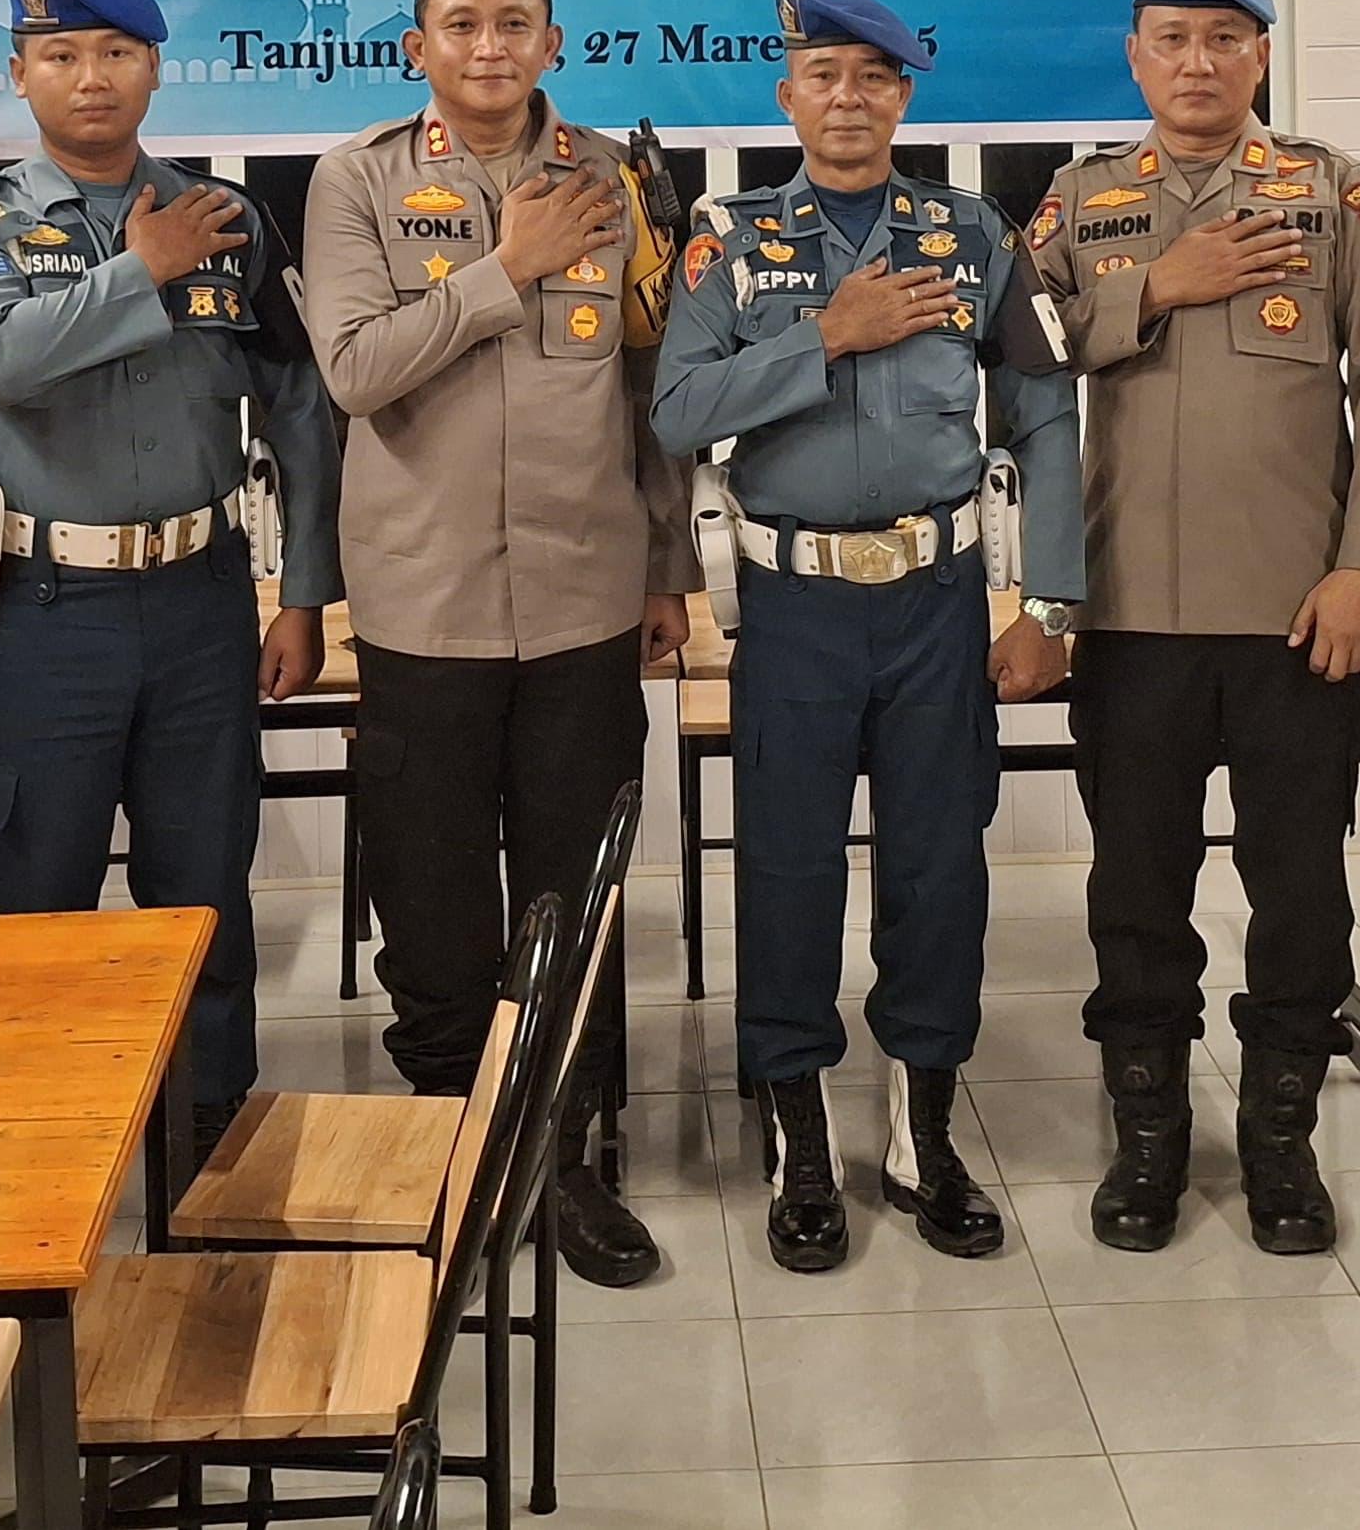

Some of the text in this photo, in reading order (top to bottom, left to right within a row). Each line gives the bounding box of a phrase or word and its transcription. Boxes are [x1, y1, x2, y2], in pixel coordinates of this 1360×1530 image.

[583, 30, 640, 65] 27
[657, 23, 785, 64] Mare
[397, 217, 473, 240] YON.E
[1077, 213, 1152, 244] DEMON
[1237, 208, 1323, 234] PLRI
[222, 255, 243, 278] AL
[954, 264, 981, 284] AL
